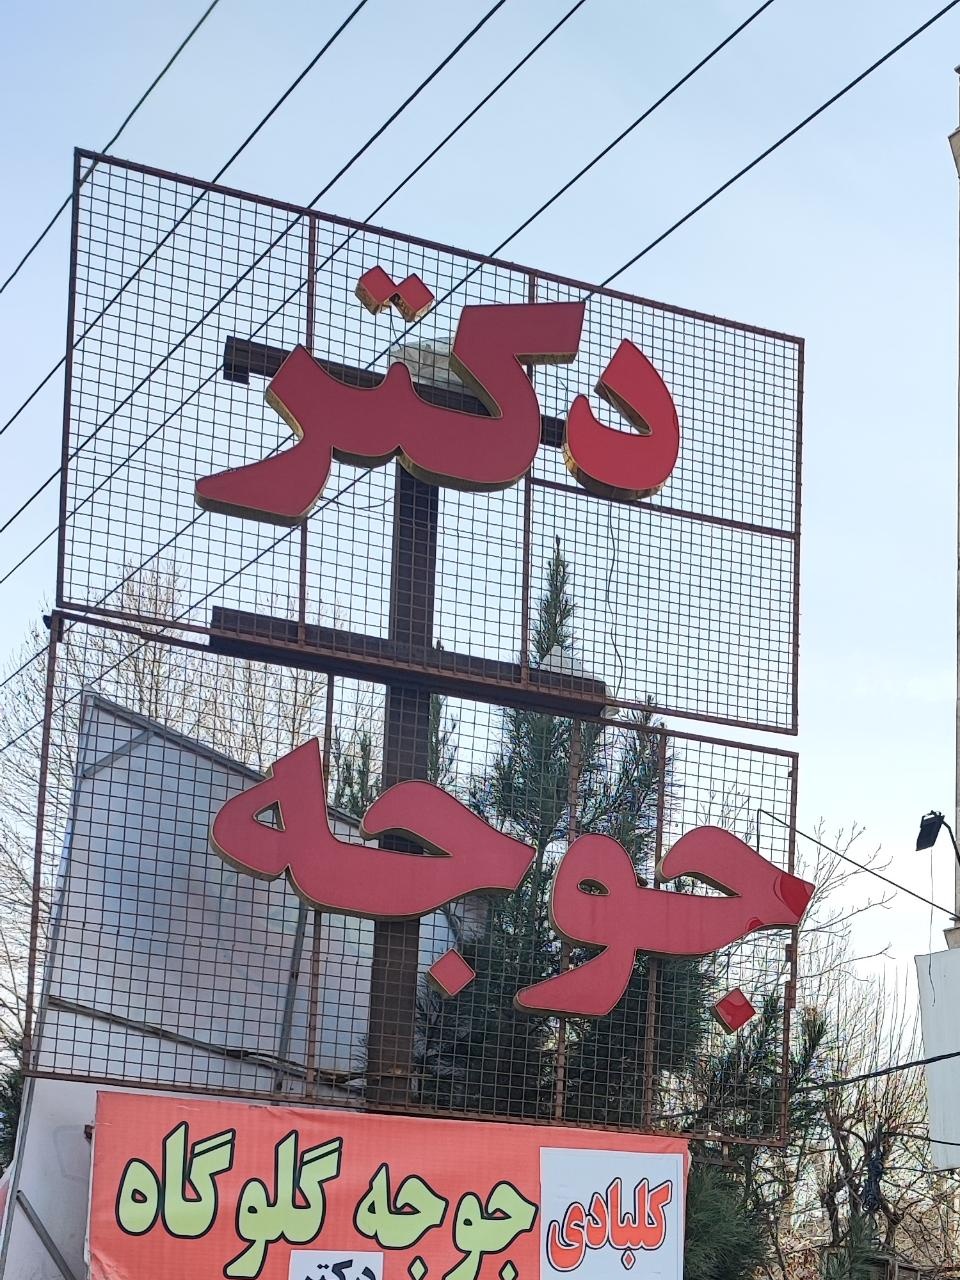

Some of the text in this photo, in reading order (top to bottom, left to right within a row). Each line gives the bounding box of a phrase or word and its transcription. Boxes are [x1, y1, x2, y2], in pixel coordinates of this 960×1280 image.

[195, 264, 680, 526] دکتر
[209, 736, 814, 1034] جوجه
[116, 1120, 344, 1280] گلوگاه
[547, 1177, 673, 1272] کلبادی
